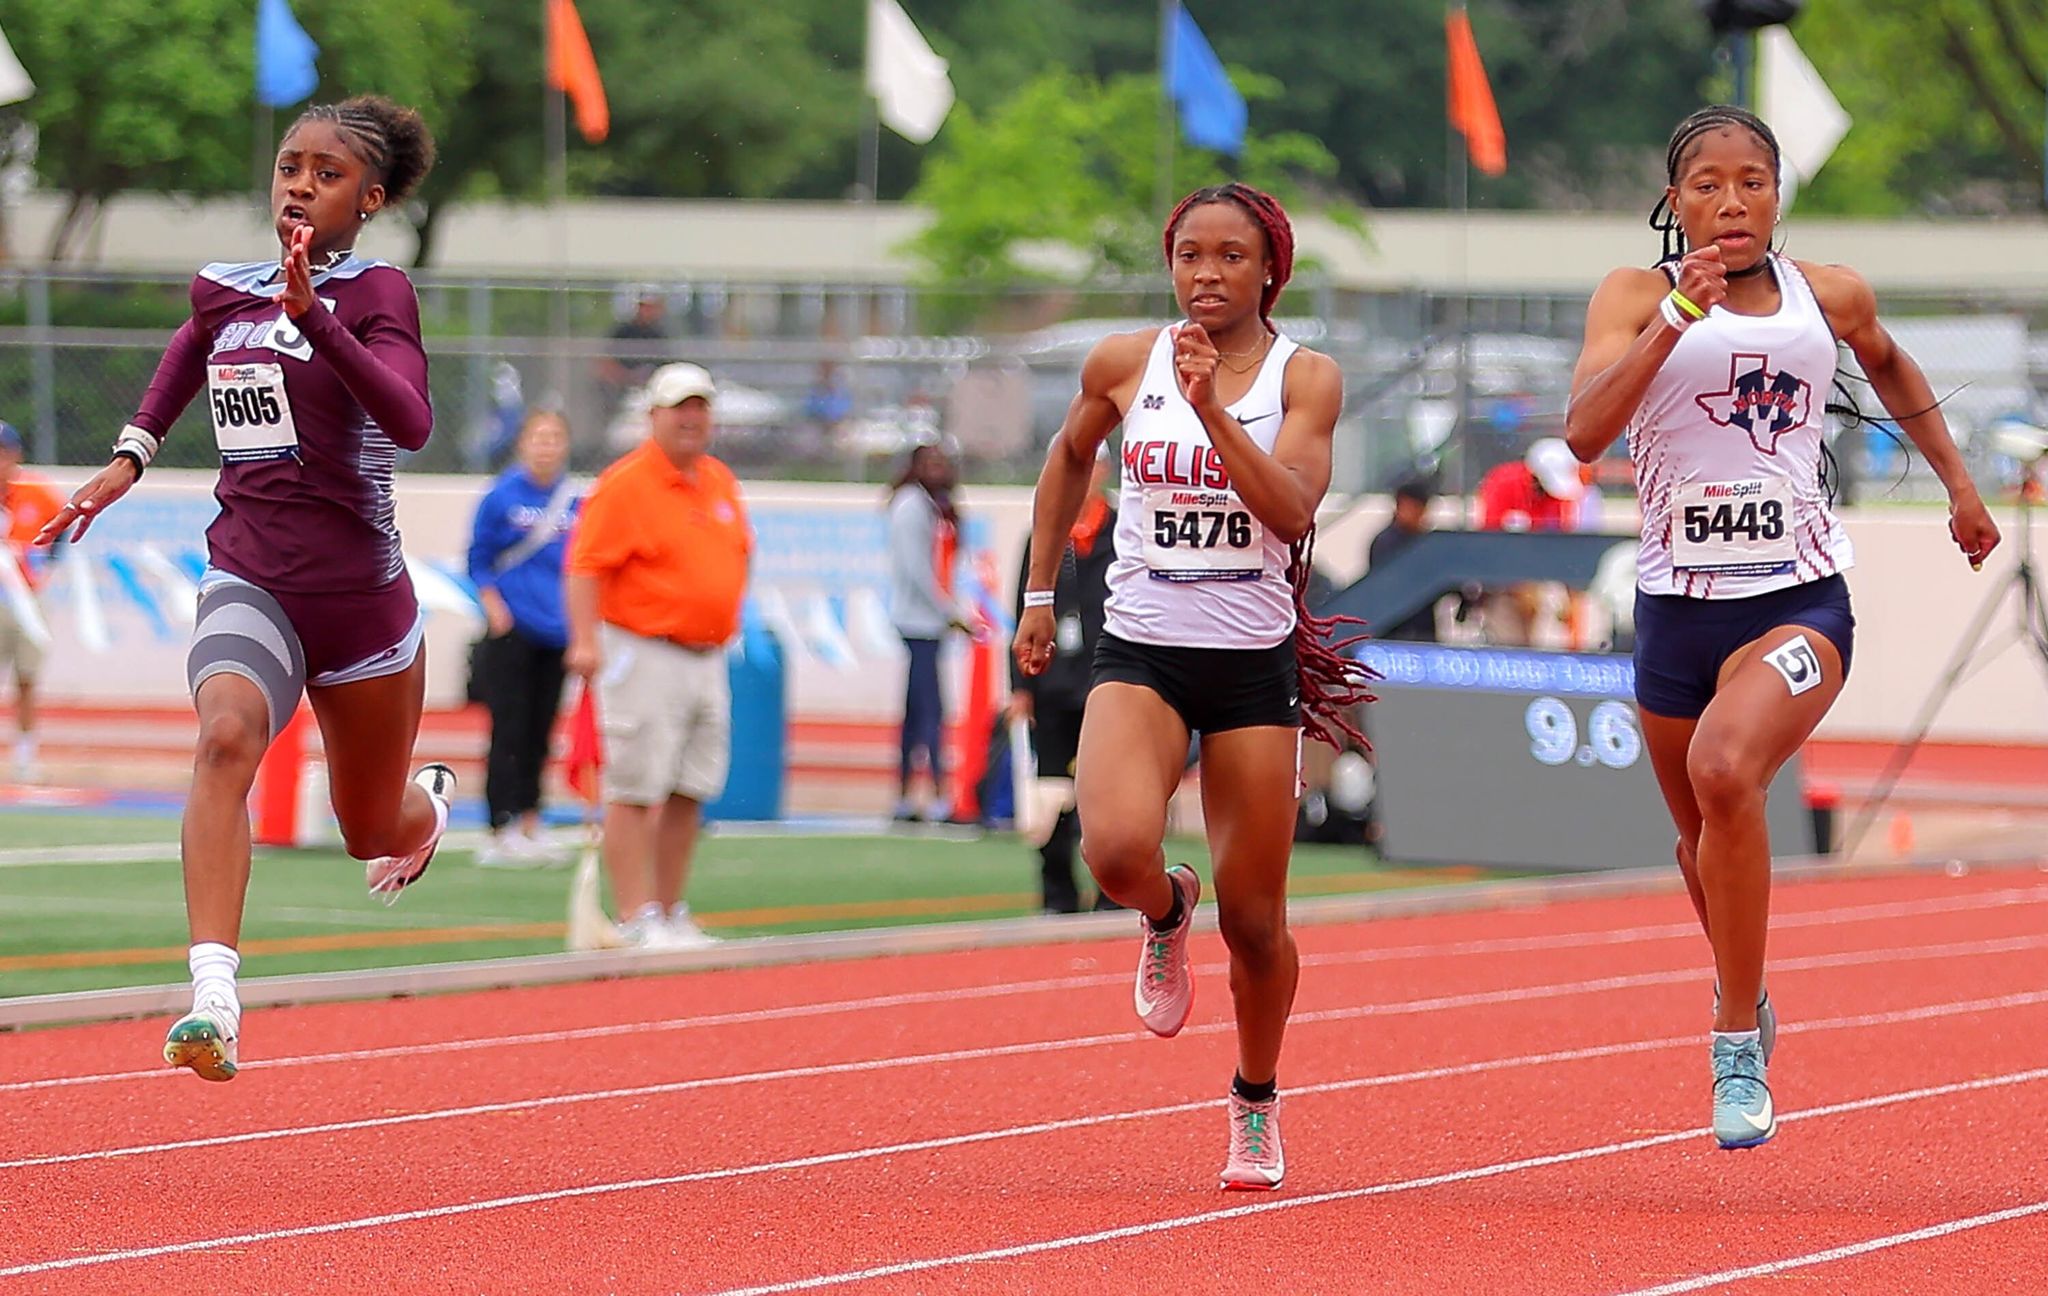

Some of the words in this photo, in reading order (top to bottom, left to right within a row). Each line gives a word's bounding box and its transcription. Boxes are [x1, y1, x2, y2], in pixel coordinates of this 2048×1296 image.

[212, 386, 282, 428] 5605
[1733, 390, 1797, 413] NORTH
[1171, 492, 1229, 508] MileSplit
[1703, 482, 1763, 499] MileSplit
[1154, 511, 1252, 549] 5476
[1684, 500, 1785, 544] 5443
[1776, 645, 1818, 683] 5
